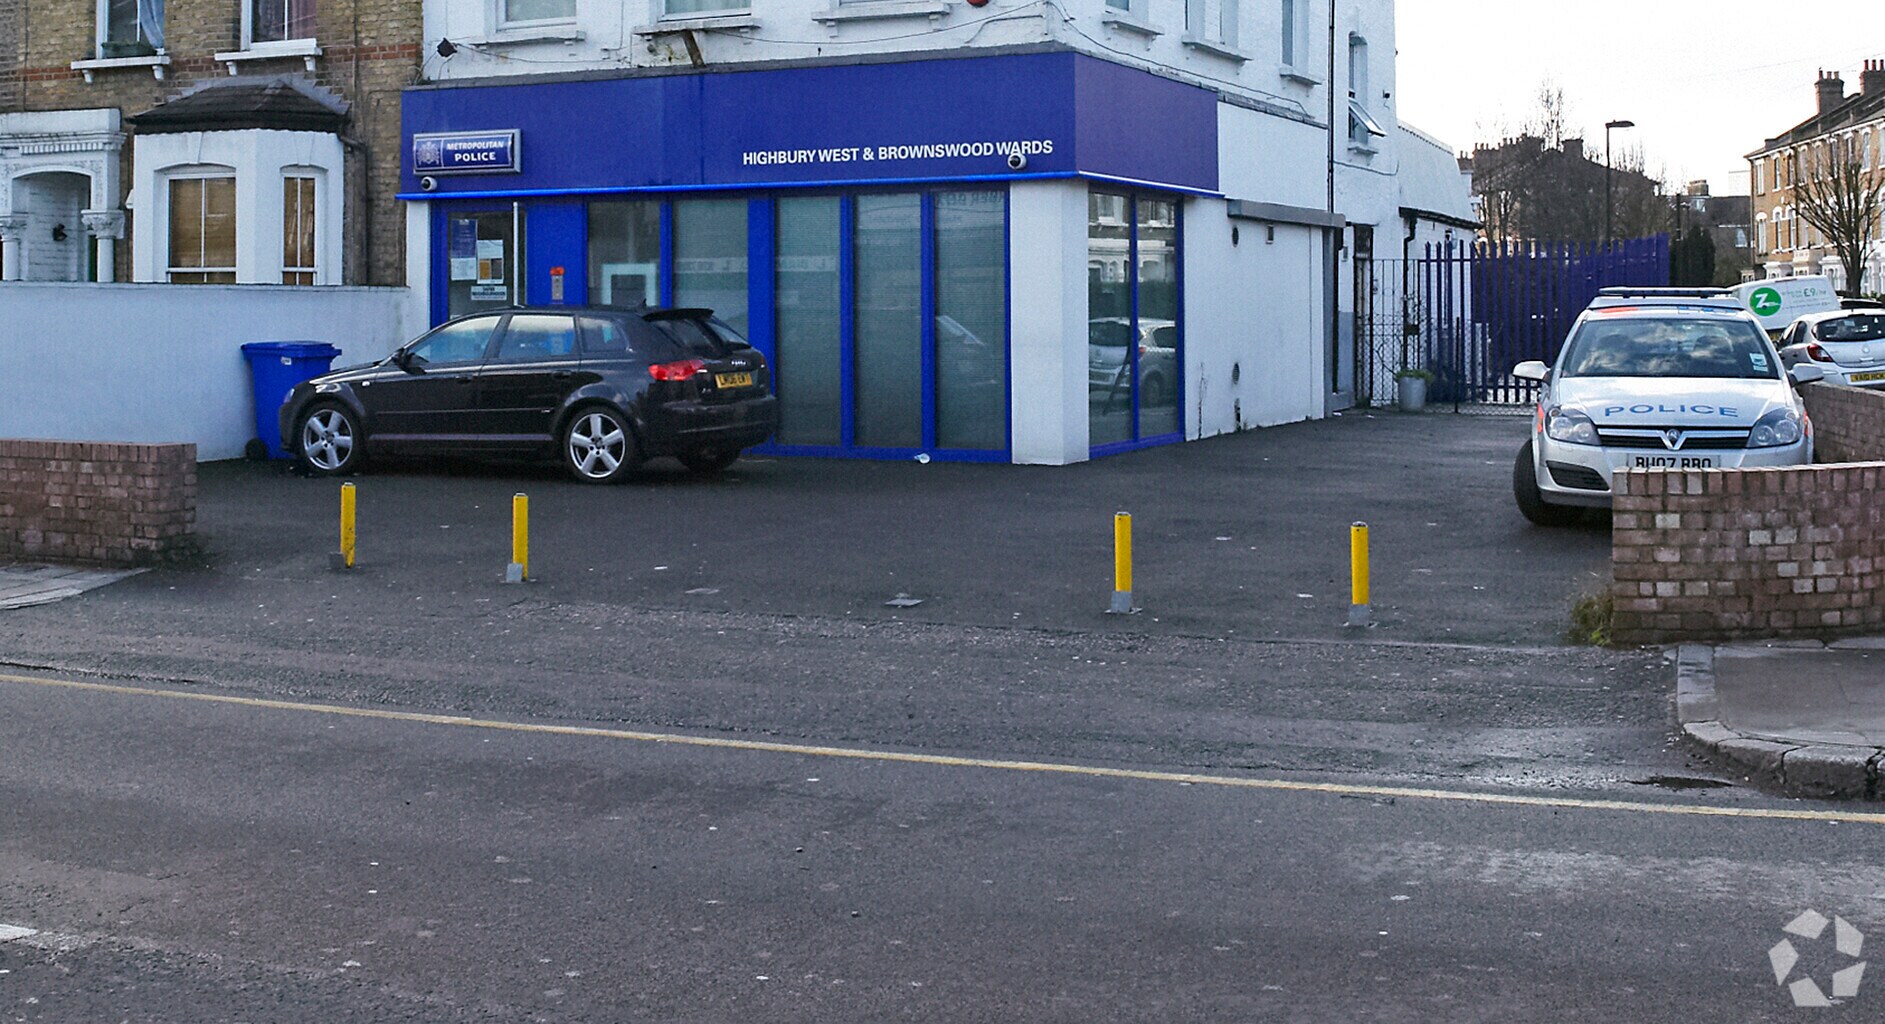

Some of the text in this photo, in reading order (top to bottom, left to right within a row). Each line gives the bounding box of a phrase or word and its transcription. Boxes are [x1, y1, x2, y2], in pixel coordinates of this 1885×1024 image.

[446, 140, 504, 151] METROPOLITAN
[454, 151, 497, 163] POLICE
[743, 140, 1053, 165] HIGHBURY WEST & BROWNSWOOD WARDS
[1604, 404, 1739, 418] POLICE
